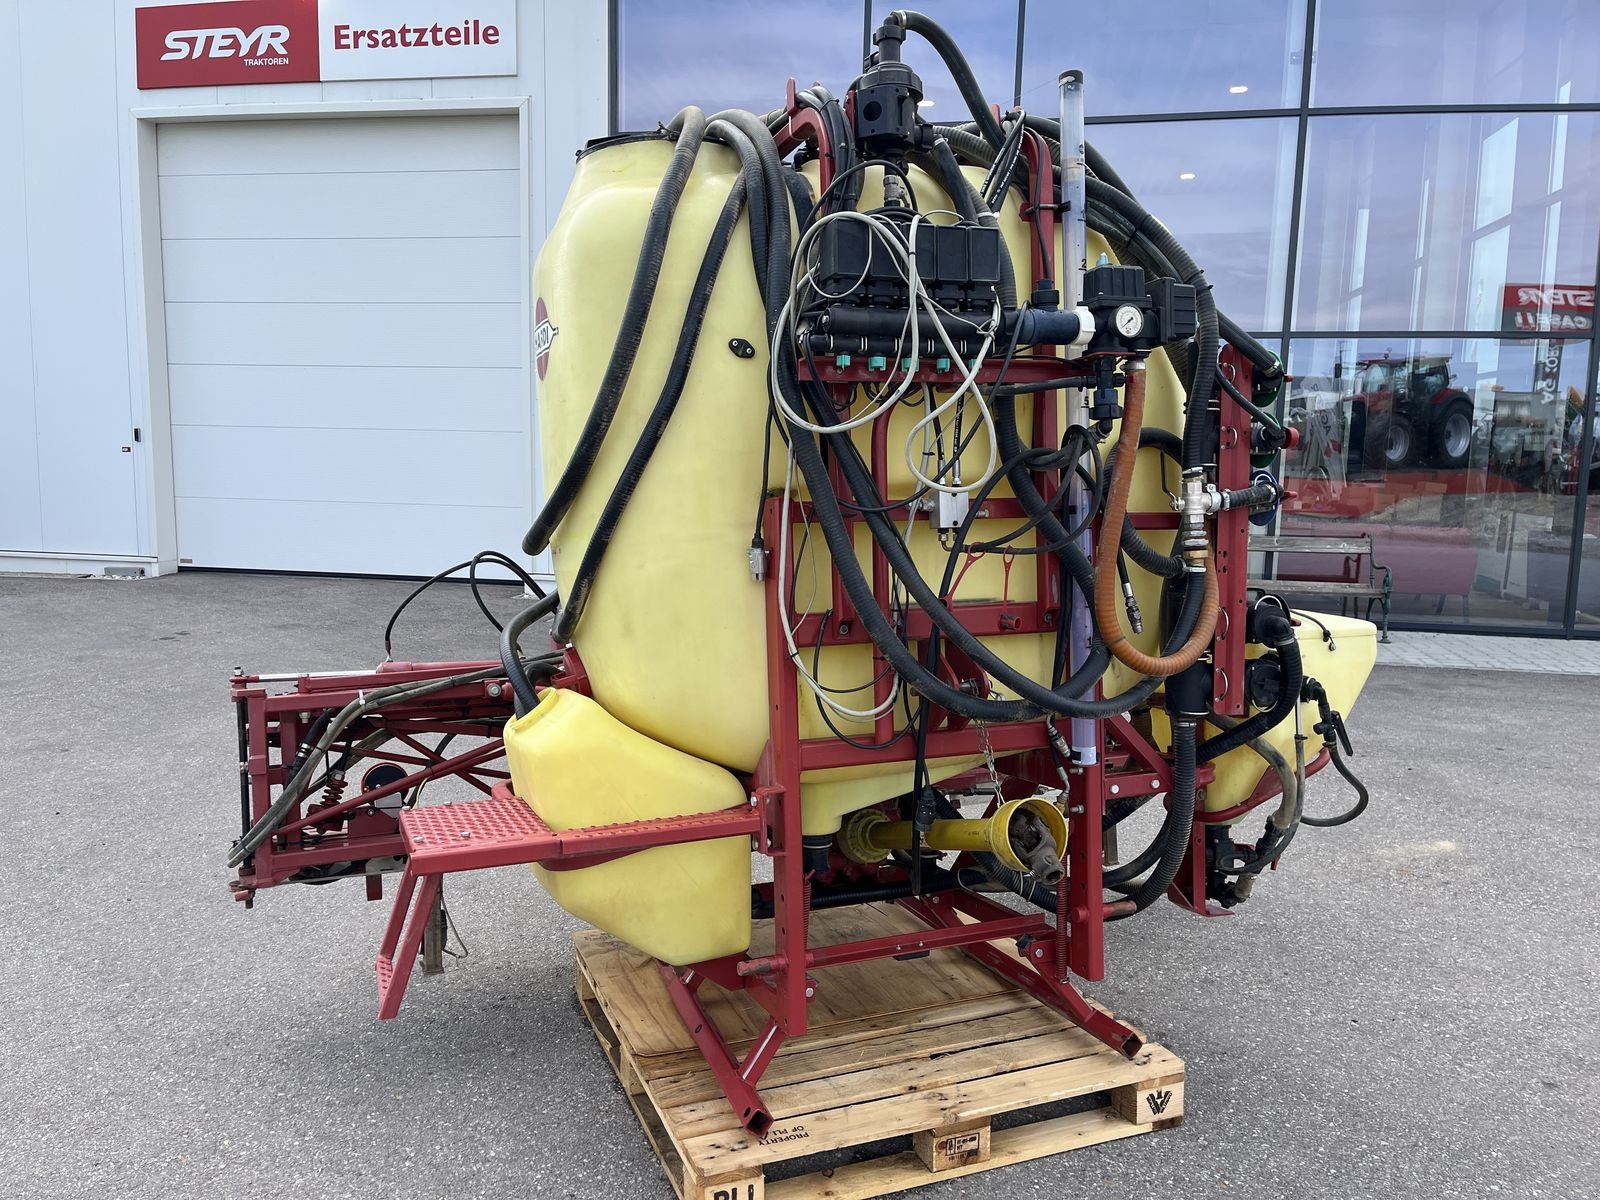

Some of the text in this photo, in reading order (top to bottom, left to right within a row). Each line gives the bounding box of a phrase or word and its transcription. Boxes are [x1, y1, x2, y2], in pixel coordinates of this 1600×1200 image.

[333, 20, 500, 50] Ersatzteile
[160, 25, 290, 60] STEYR
[244, 57, 289, 66] TRAKTOREN
[792, 1125, 804, 1133] OF
[759, 1132, 809, 1146] PROPERTY
